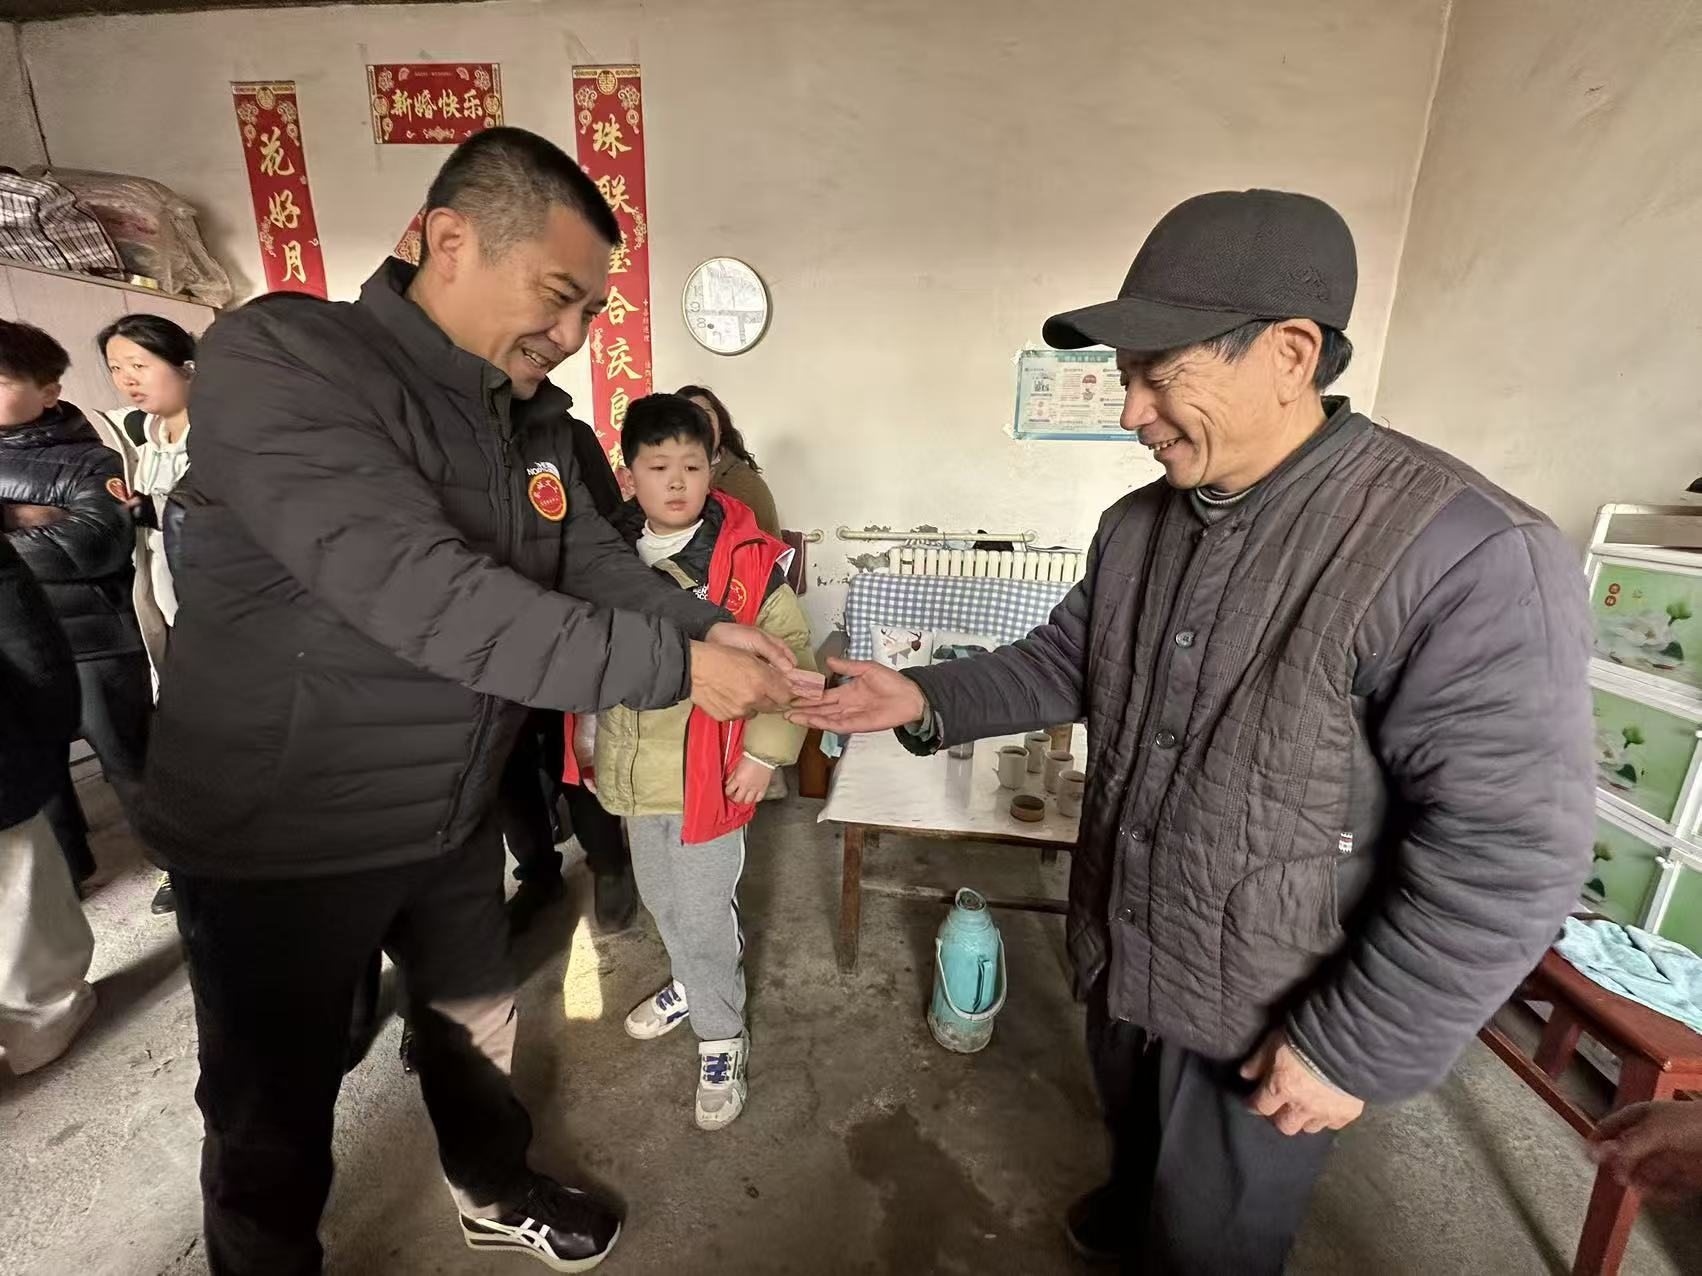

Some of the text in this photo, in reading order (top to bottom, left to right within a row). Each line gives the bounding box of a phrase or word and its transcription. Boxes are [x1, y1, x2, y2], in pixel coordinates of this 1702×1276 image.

[390, 88, 483, 123] 新婚快乐
[259, 126, 307, 284] 花好月
